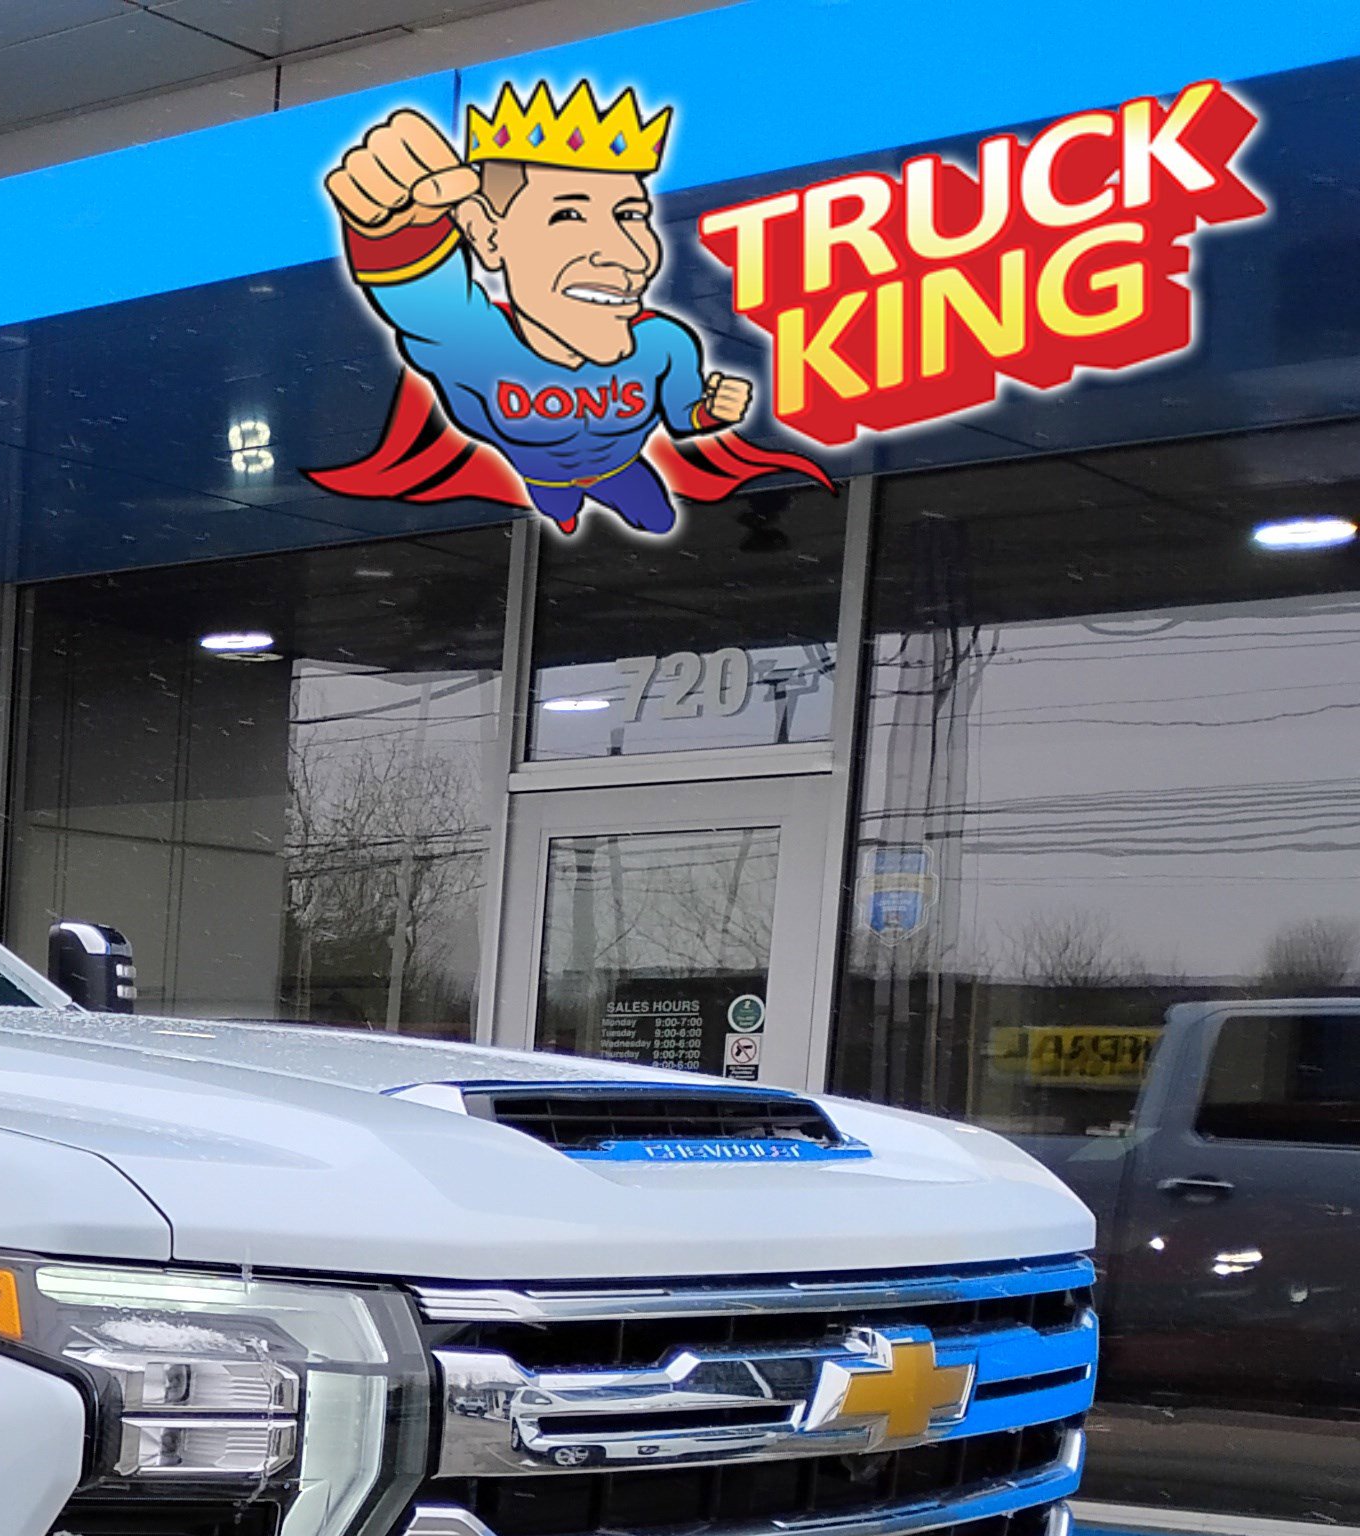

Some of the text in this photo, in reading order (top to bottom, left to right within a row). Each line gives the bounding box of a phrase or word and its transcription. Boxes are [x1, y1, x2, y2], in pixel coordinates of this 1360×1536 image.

[616, 647, 752, 722] 720
[607, 1000, 700, 1013] SALES HOURS
[601, 1018, 637, 1028] Monday
[601, 1028, 637, 1038] Tuesday
[600, 1040, 652, 1049] Wednesday
